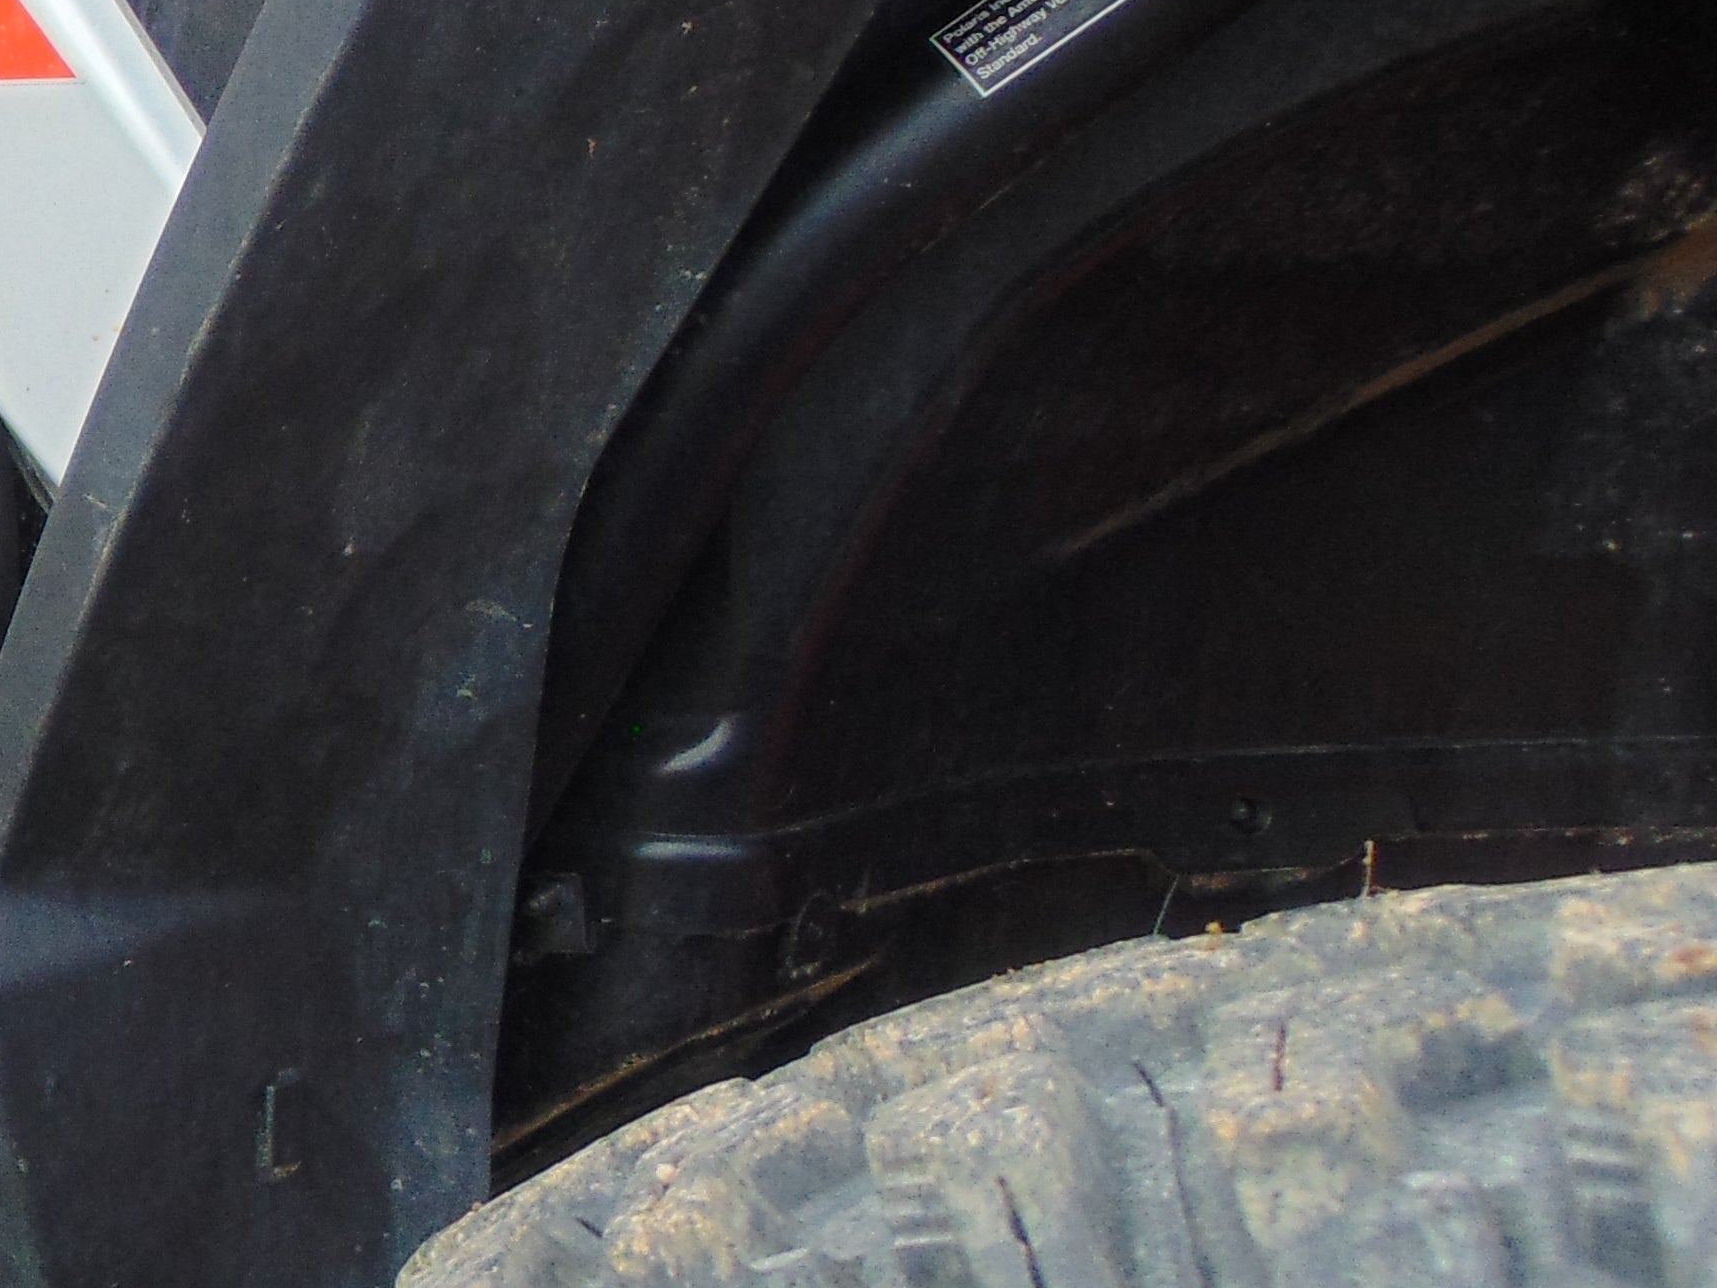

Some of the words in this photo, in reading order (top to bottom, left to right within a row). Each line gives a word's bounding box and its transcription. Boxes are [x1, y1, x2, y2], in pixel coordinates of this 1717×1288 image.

[942, 10, 989, 43] Polaris
[955, 32, 984, 53] with
[983, 15, 1007, 33] the
[965, 8, 1046, 65] Off-Highway
[976, 33, 1041, 78] Standard.
